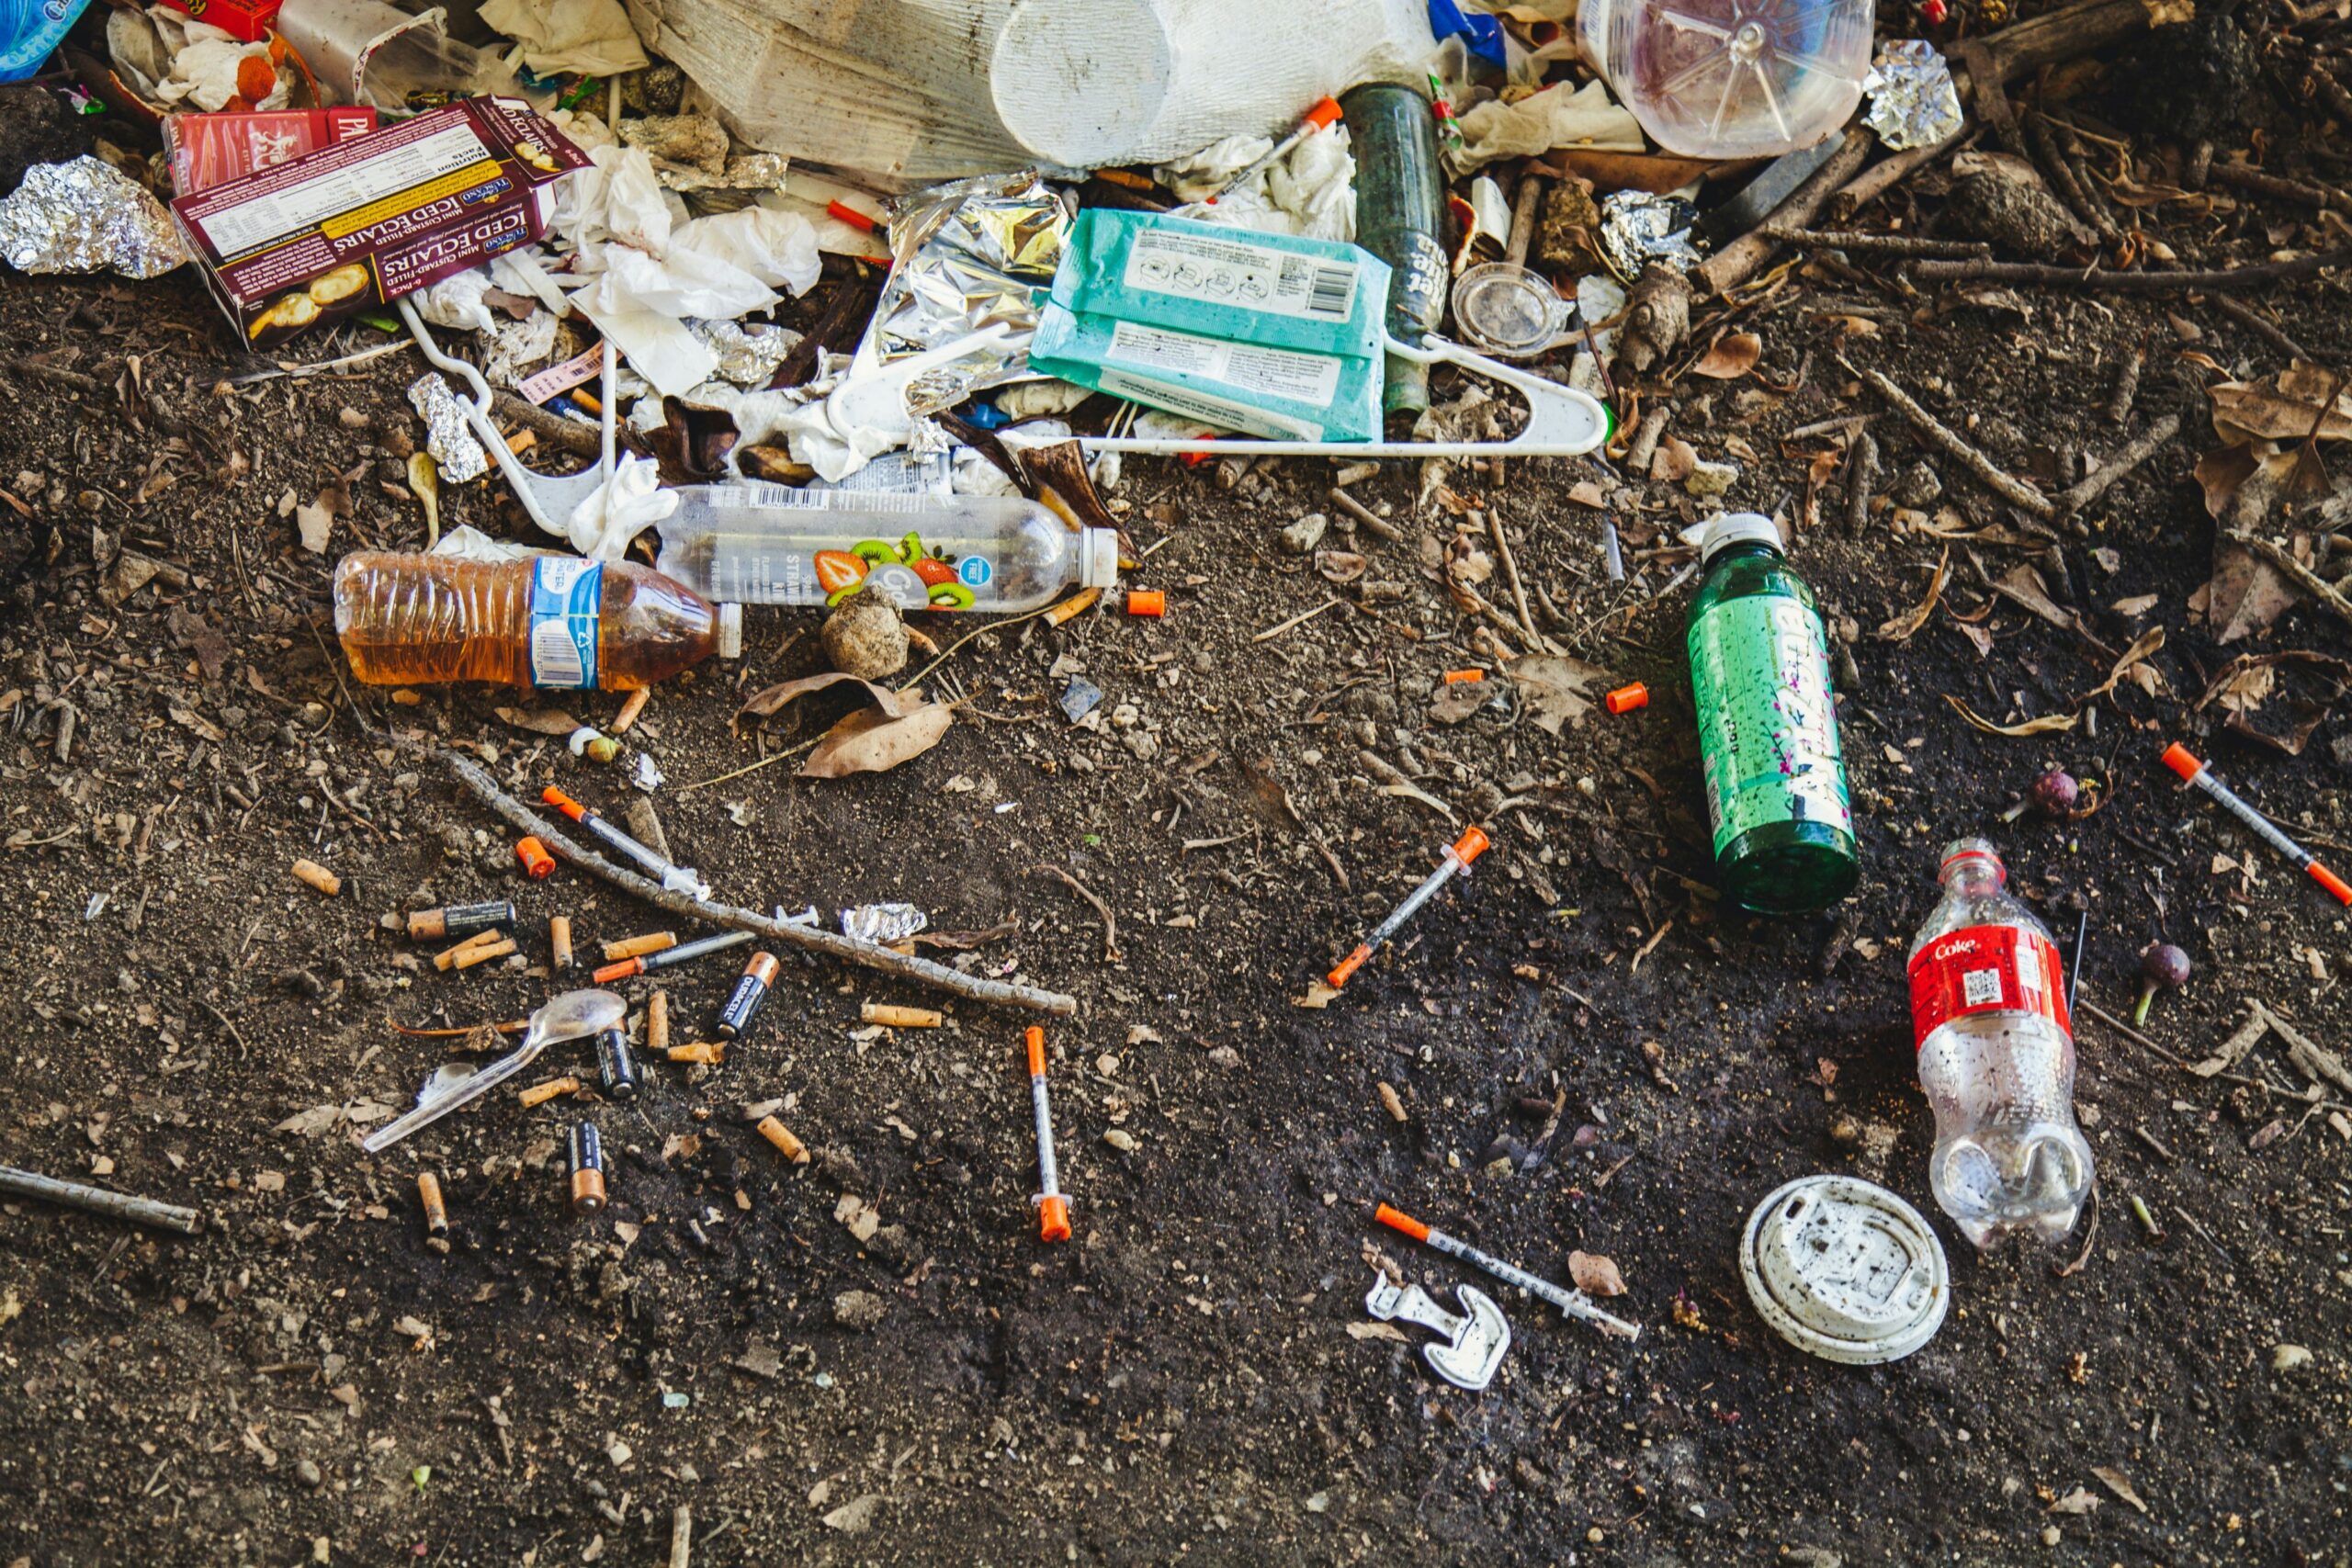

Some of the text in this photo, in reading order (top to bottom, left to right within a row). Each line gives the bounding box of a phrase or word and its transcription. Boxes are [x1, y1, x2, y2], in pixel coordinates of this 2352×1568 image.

[450, 145, 482, 160] Facts
[507, 114, 548, 153] ECLAIRS
[435, 150, 487, 174] Nutrition
[461, 177, 509, 201] TUSCANO
[332, 196, 461, 254] ICED ECLAIRS
[374, 206, 464, 246] MINI CUSTARD-FILLED
[382, 209, 527, 277] ICED ECLAIRS
[385, 243, 481, 287] MINI CUSTARD-FILLED
[389, 277, 423, 296] 6-PACK
[1932, 935, 1977, 961] Coke
[722, 975, 754, 1017] DURACELL
